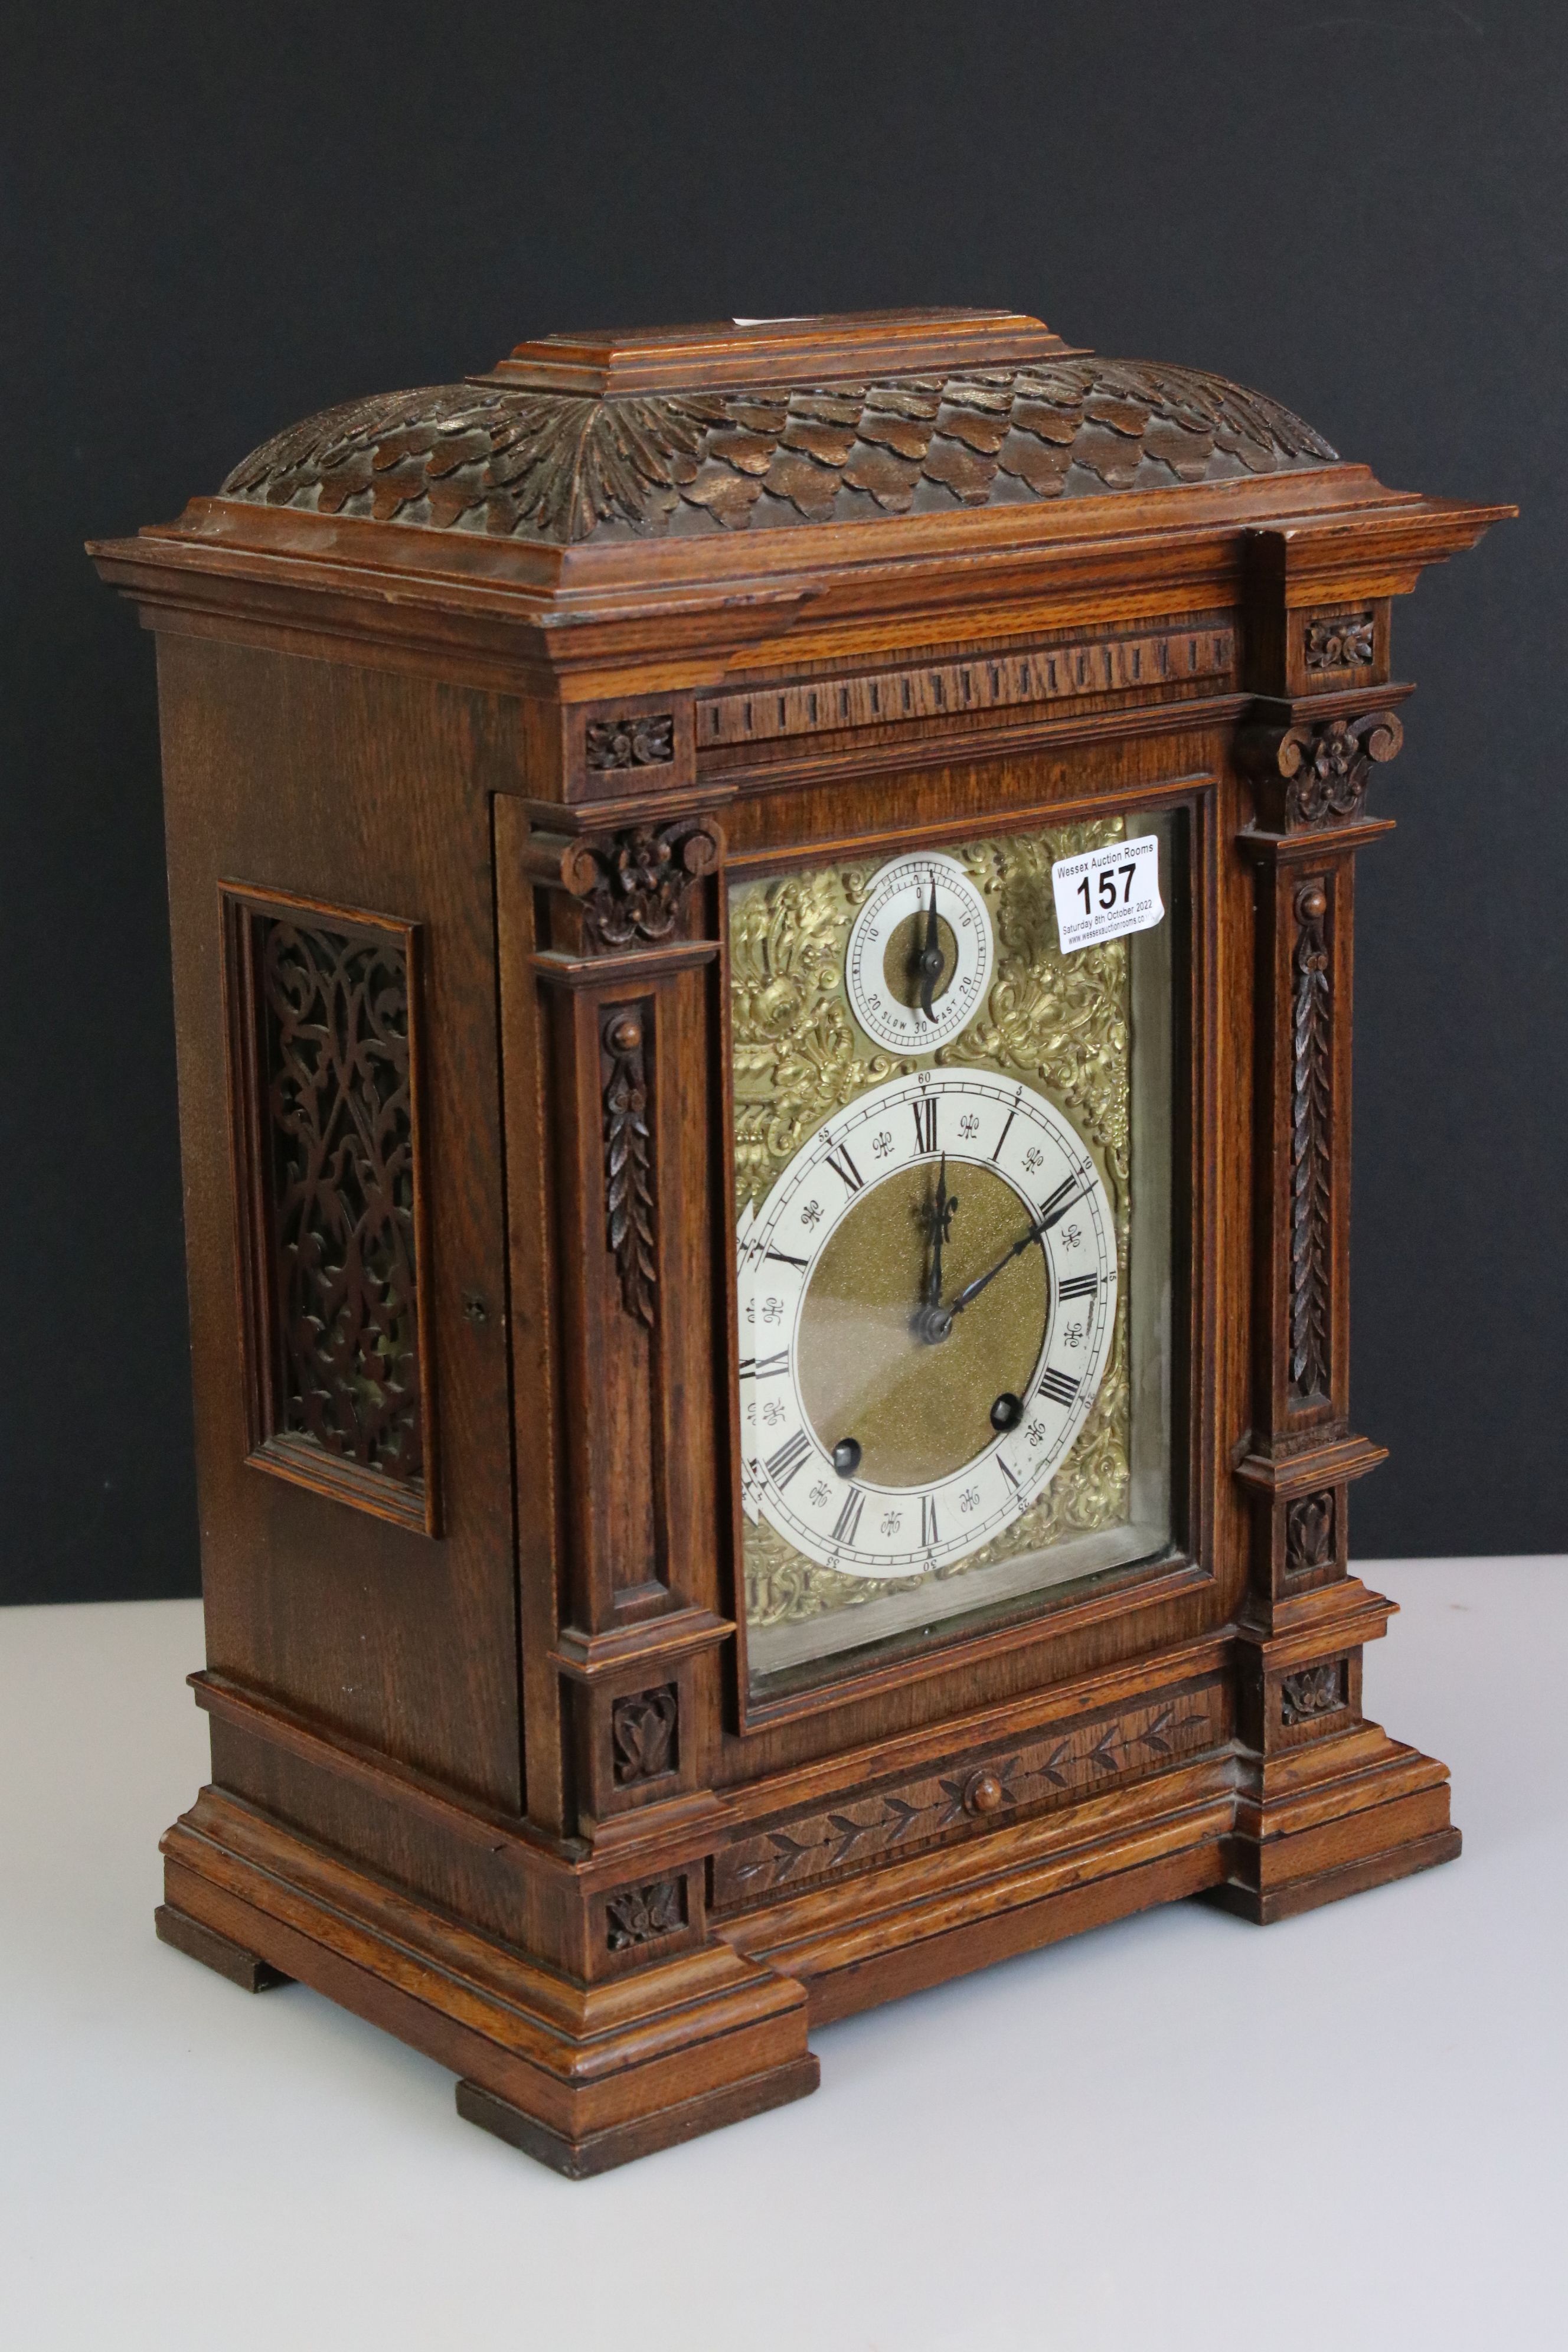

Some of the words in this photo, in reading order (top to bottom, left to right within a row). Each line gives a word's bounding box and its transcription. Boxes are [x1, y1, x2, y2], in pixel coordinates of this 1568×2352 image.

[1057, 861, 1089, 878] Wessex
[1091, 852, 1122, 868] Auction
[1124, 844, 1154, 858] Rooms
[1077, 863, 1136, 915] 157
[958, 912, 971, 927] 10
[1063, 919, 1093, 935] Saturday
[1095, 915, 1105, 925] 8th
[1107, 906, 1134, 920] October
[1136, 899, 1152, 912] 2022
[867, 928, 879, 942] 10
[959, 976, 972, 994] 20
[868, 994, 881, 1011] 20
[936, 999, 958, 1022] FAST
[881, 1011, 907, 1030] SLOW
[914, 1021, 927, 1034] 30
[918, 1072, 931, 1084] 60
[1016, 1086, 1023, 1096] 5
[818, 1127, 830, 1142] 55
[907, 1097, 940, 1157] XII
[1084, 1155, 1093, 1170] 10
[822, 1139, 869, 1204] XI
[1109, 1270, 1116, 1282] 15
[1084, 1392, 1097, 1410] 20
[1016, 1498, 1031, 1514] 25
[826, 1556, 841, 1570] 35
[923, 1558, 938, 1572] 30
